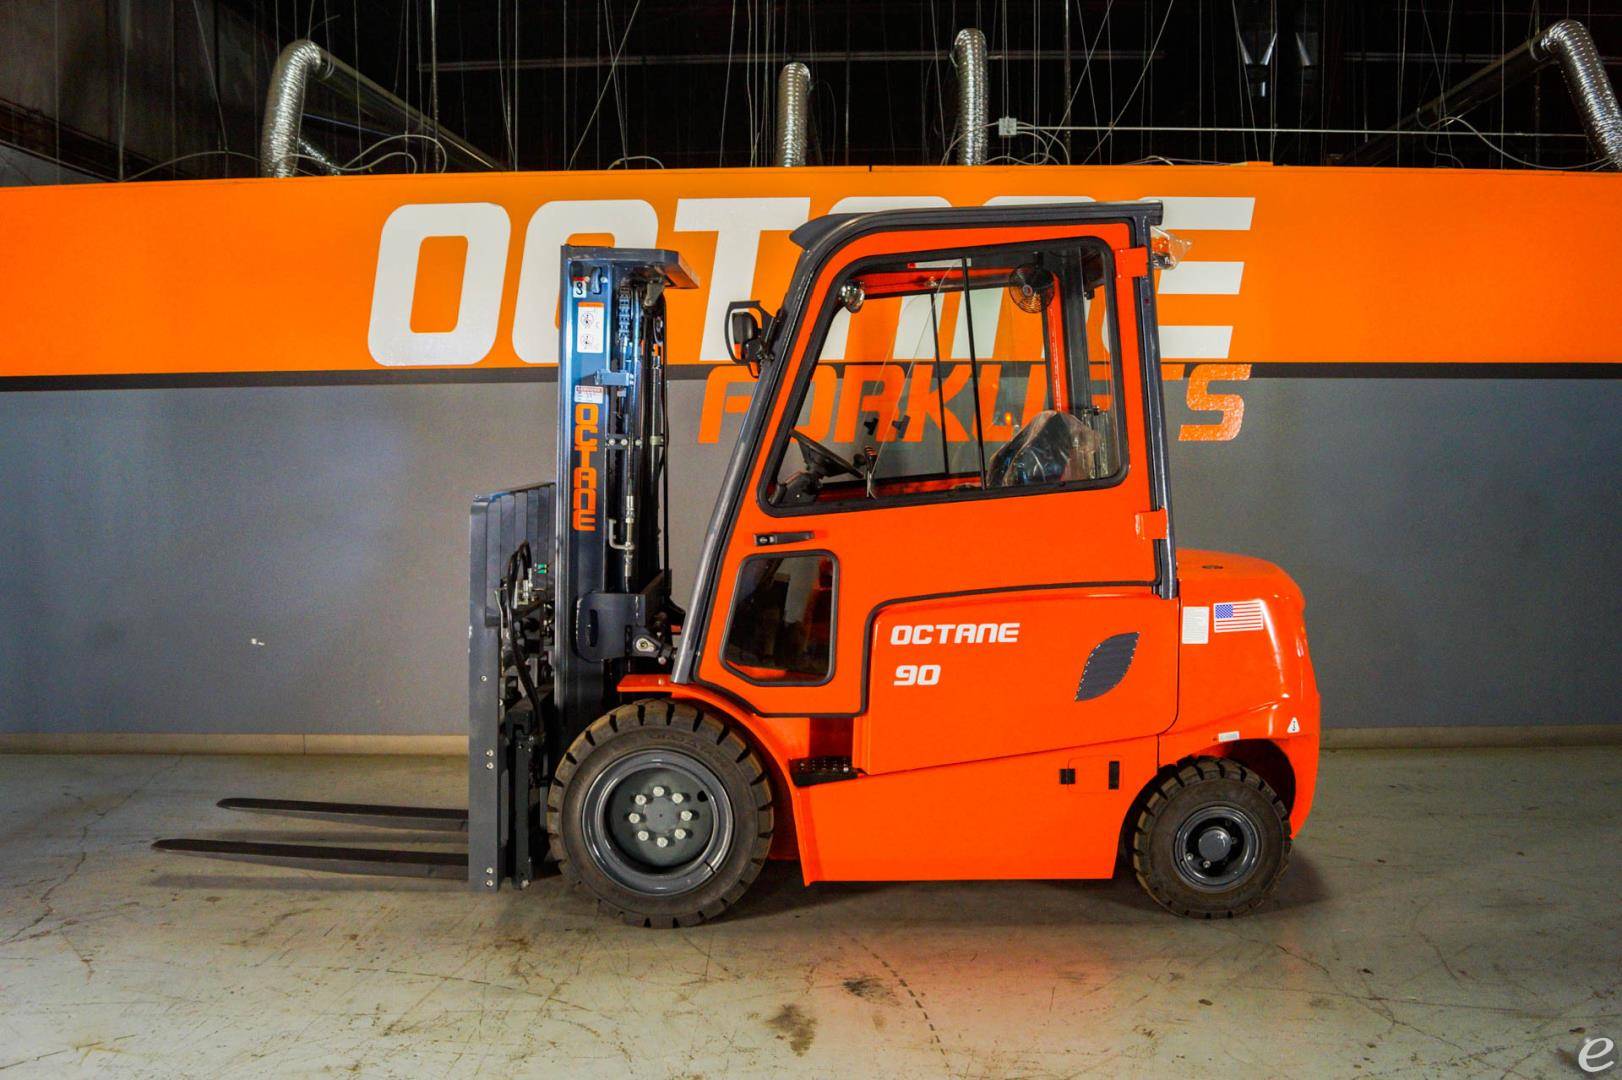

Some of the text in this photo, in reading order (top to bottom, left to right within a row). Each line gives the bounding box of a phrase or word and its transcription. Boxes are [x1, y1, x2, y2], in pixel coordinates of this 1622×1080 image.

[572, 403, 599, 531] OCTANE
[890, 622, 1021, 645] OCTANE
[893, 664, 941, 686] 90
